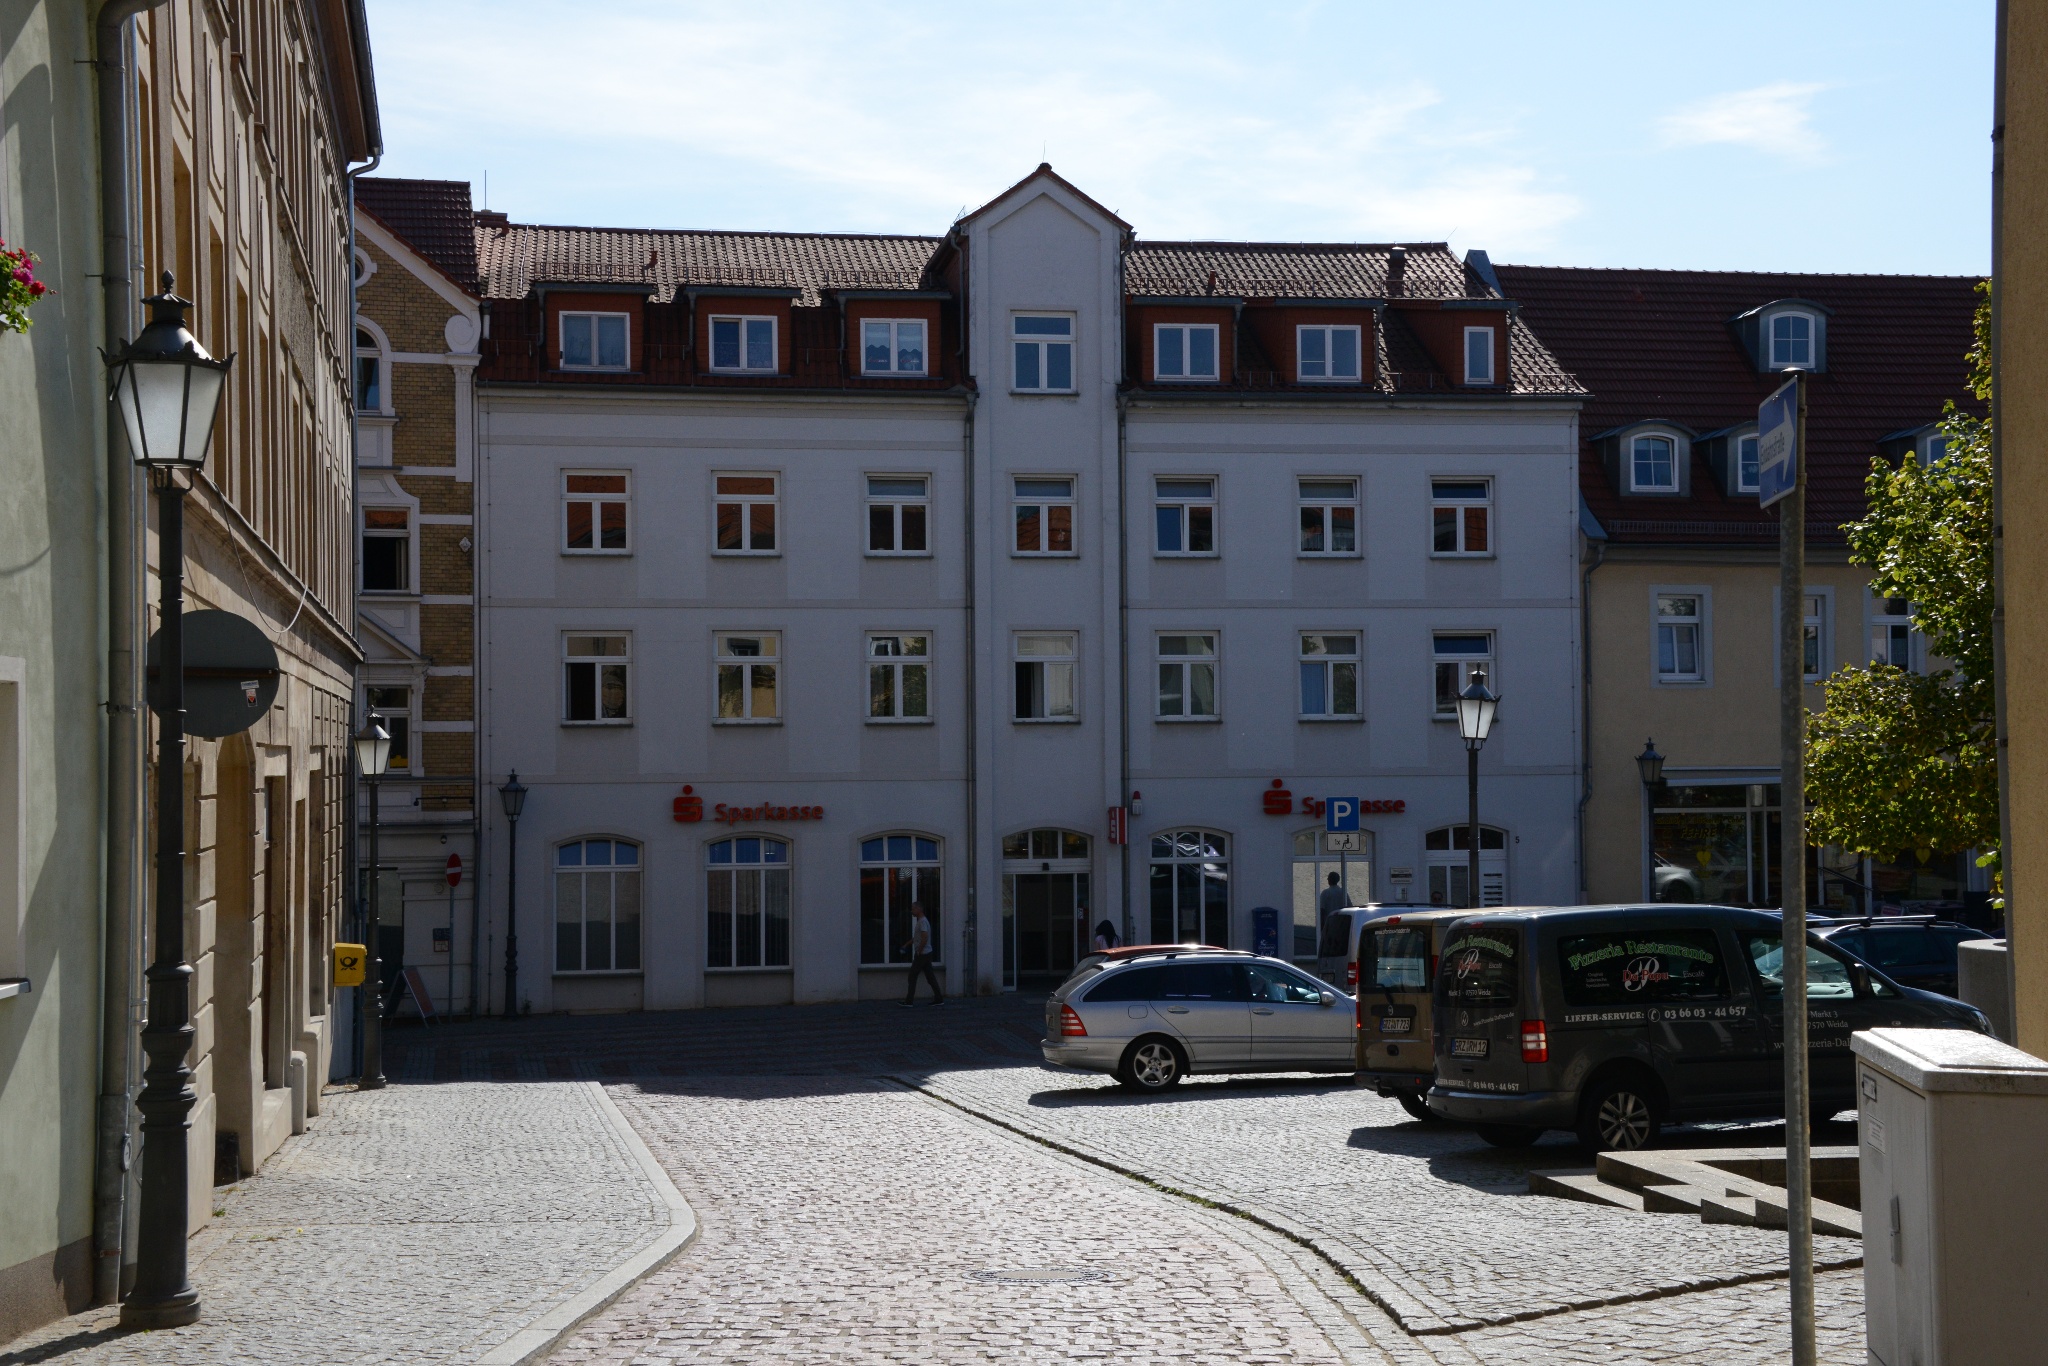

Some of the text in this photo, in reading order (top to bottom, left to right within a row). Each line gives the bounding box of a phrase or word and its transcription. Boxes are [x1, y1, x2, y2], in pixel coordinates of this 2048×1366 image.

[715, 802, 823, 826] Sparkasse
[1302, 797, 1406, 819] Spasse
[1333, 801, 1352, 828] P
[1515, 836, 1521, 845] 5
[1568, 939, 1714, 971] Pizzeria Restaurante
[1682, 970, 1705, 979] Eiscafé
[1565, 1005, 1747, 1023] LIEFER-SERVICE: 03 66 03 44 657
[1810, 1010, 1839, 1019] Markt 3
[1807, 1020, 1849, 1030] 7570 Weida
